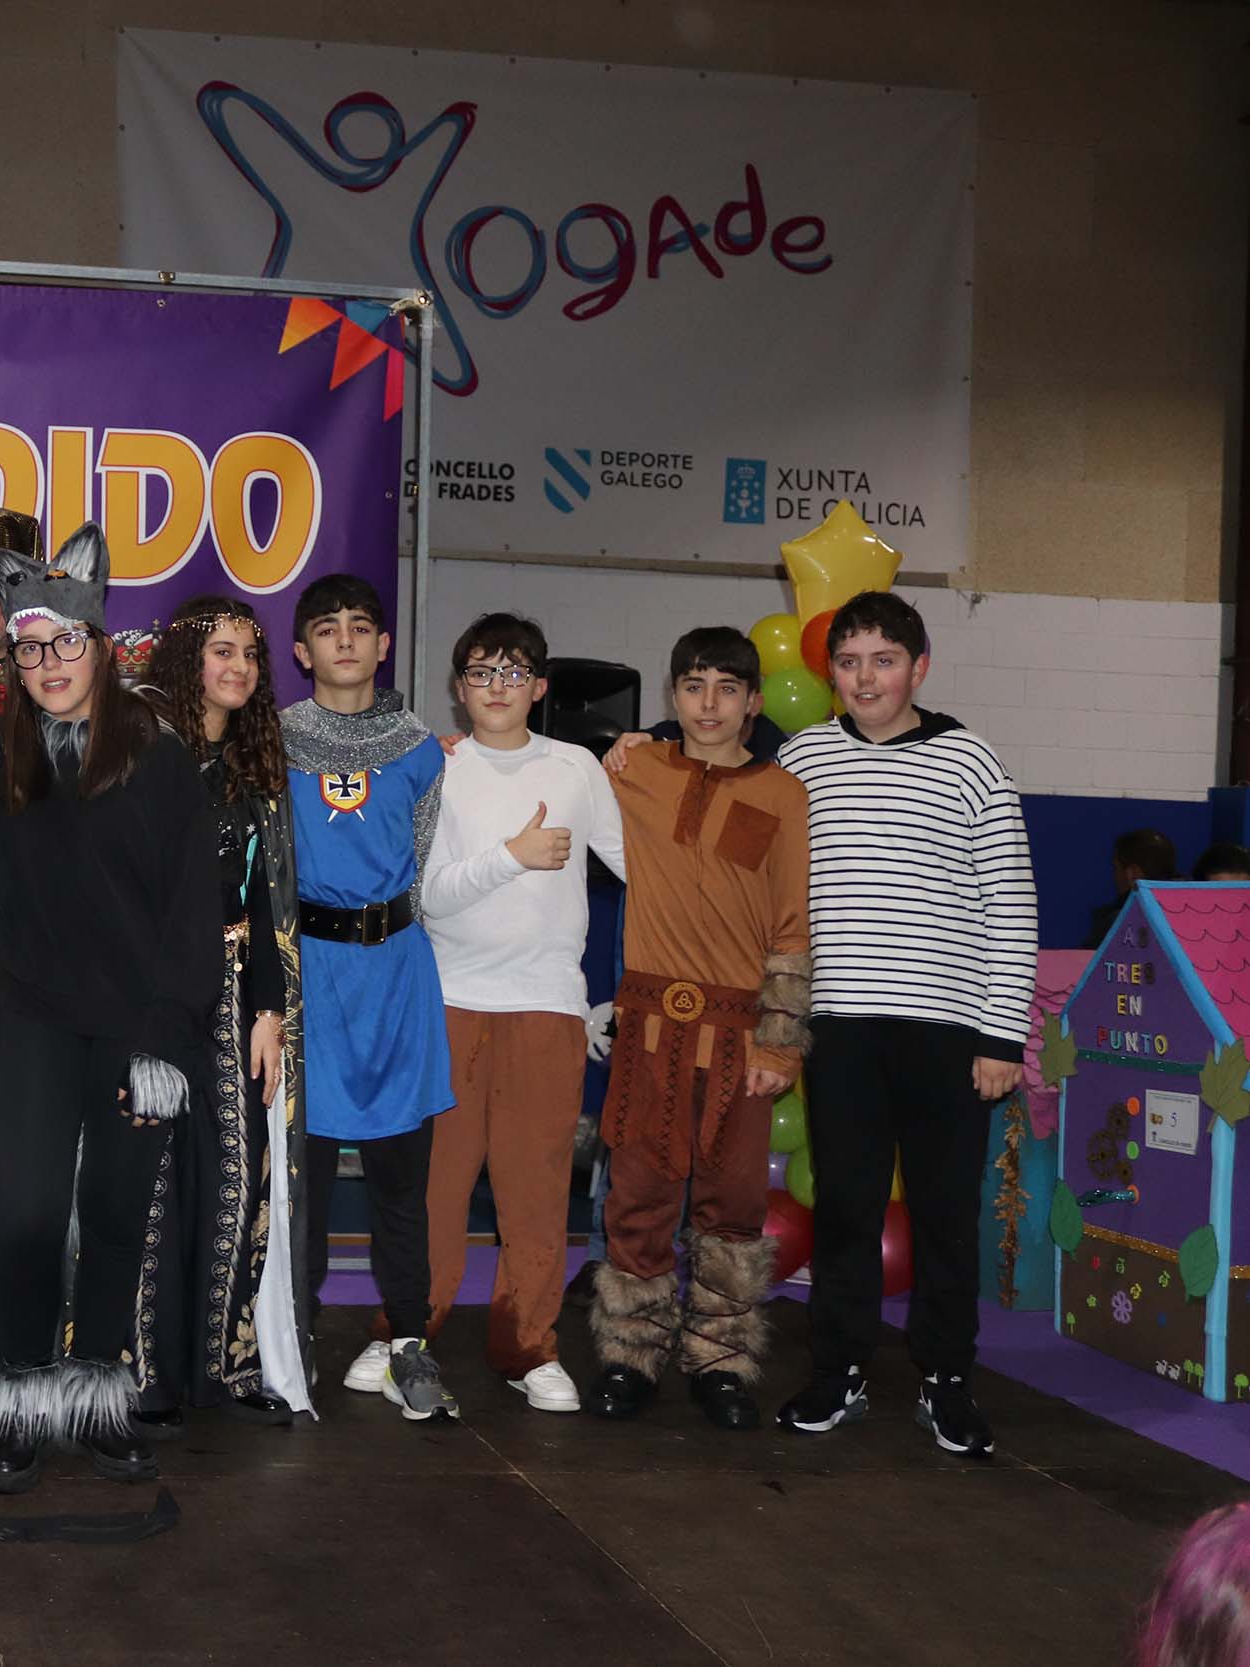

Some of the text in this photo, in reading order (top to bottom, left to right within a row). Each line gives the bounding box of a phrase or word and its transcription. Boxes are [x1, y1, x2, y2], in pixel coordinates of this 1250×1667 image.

[404, 459, 515, 481] CNCELLO
[600, 451, 693, 471] DEPORTE
[600, 470, 683, 490] GALEGO
[777, 467, 871, 495] XUNTA
[438, 482, 515, 502] FRADES
[776, 497, 812, 521] DE
[1116, 993, 1143, 1016] EN
[1096, 1023, 1168, 1055] PUNTO
